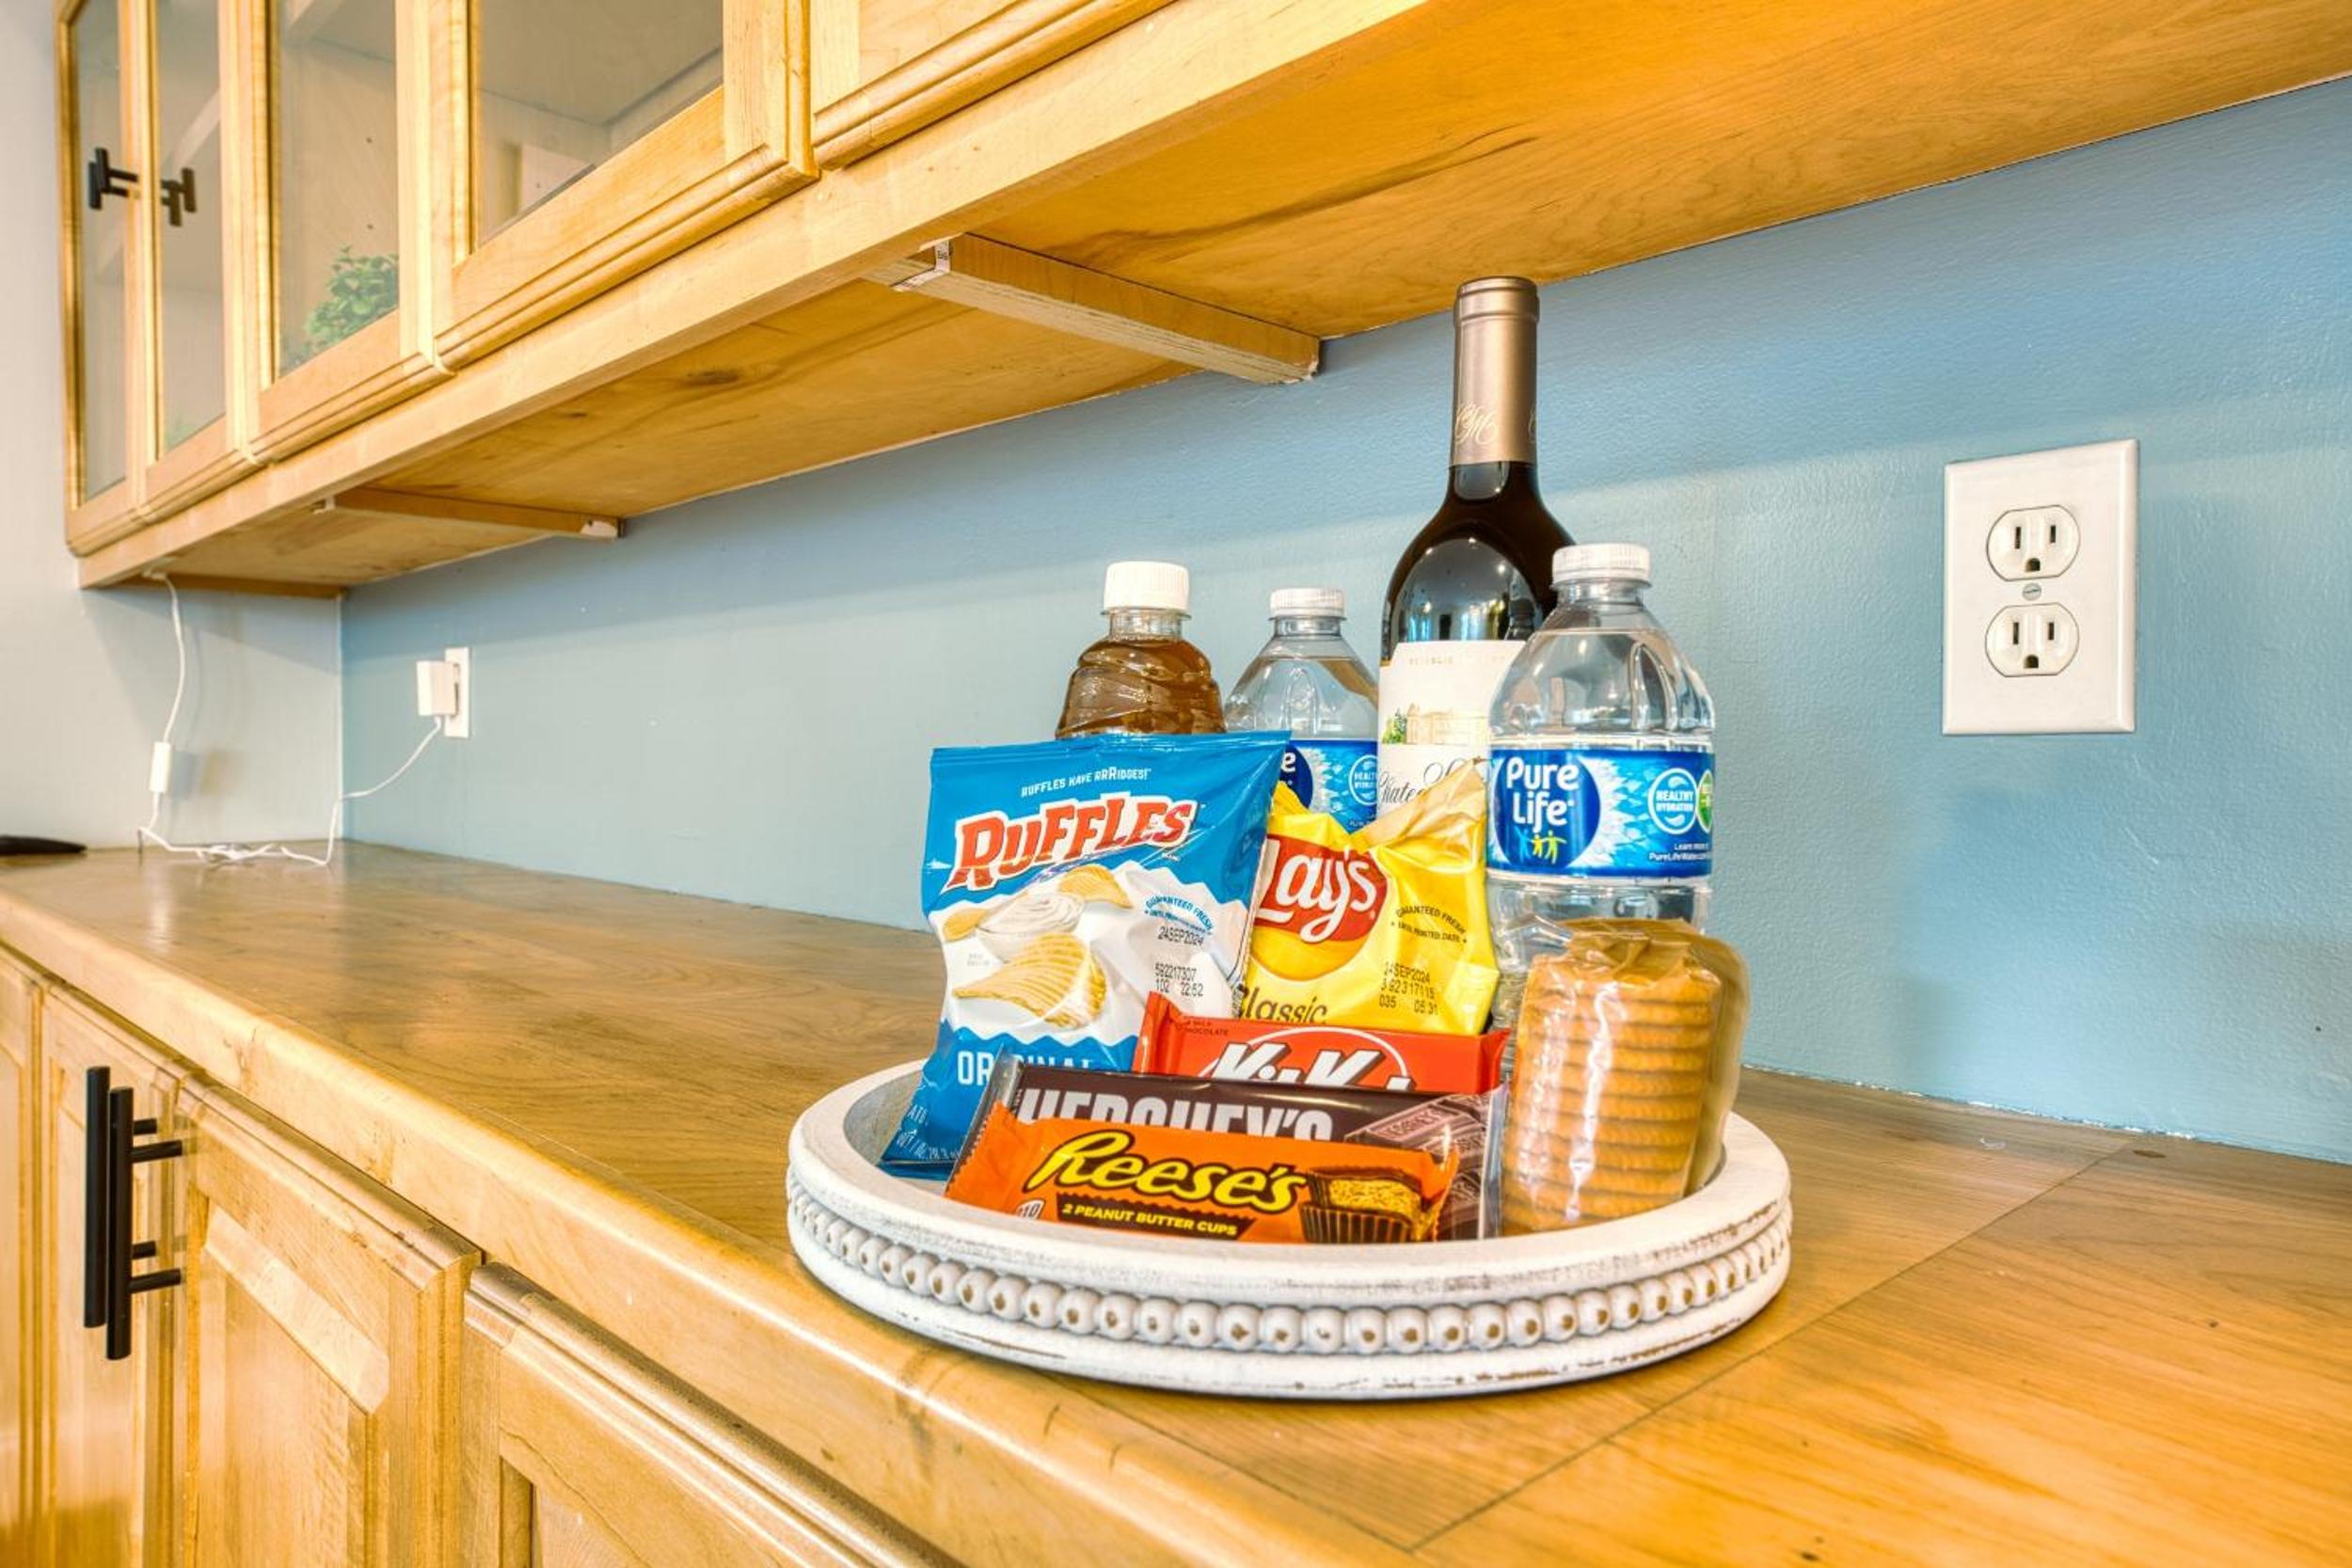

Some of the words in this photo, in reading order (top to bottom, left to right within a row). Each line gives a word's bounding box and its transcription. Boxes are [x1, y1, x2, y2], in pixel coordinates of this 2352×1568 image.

[1021, 778, 1066, 798] RUFFLES
[1068, 772, 1093, 787] HAVE
[1507, 756, 1580, 790] Pure
[1513, 791, 1568, 833] Life
[1655, 790, 1694, 802] HEALTHY
[945, 795, 1196, 890] RUFFLES
[1192, 906, 1215, 932] FRESH
[1379, 994, 1397, 1008] 035
[1026, 1131, 1309, 1212] Reese's
[1061, 1203, 1073, 1214] 2
[1073, 1205, 1135, 1221] PEANUT
[1136, 1212, 1195, 1230] BUTTER
[1196, 1220, 1238, 1236] CUPS
